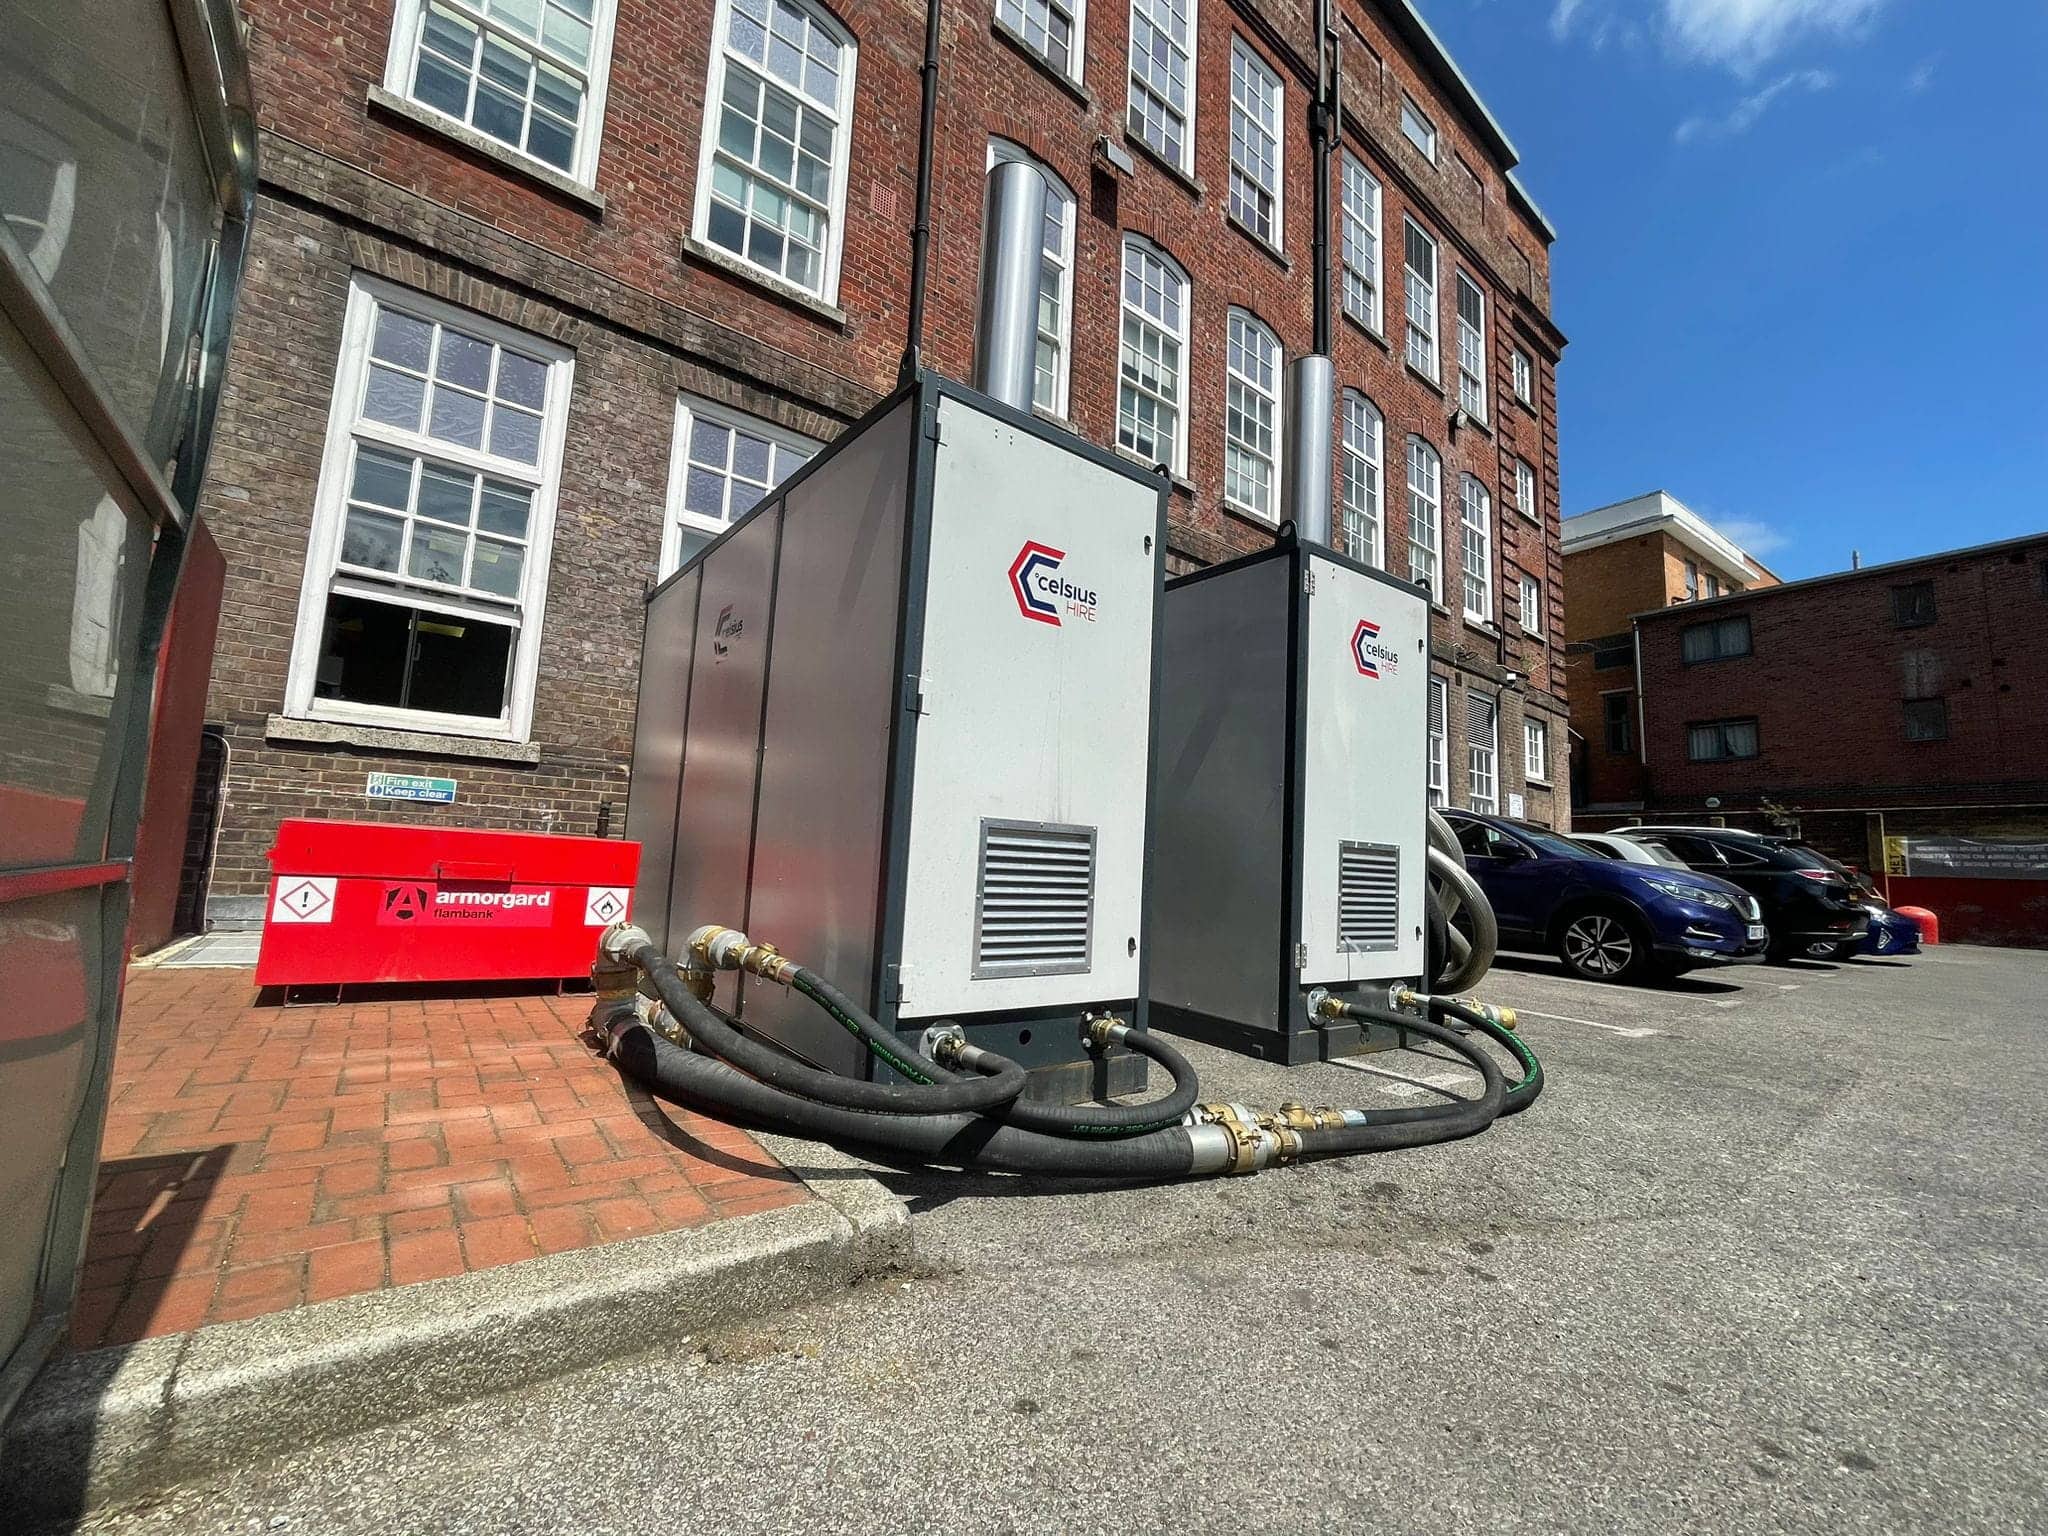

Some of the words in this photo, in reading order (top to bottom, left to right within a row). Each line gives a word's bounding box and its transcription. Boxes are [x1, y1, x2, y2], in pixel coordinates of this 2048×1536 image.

[1066, 601, 1097, 622] HIRE
[386, 776, 409, 787] Fire
[411, 779, 433, 788] exit
[385, 786, 416, 797] Keep
[418, 789, 448, 799] clear
[435, 891, 551, 909] armorgard
[433, 908, 495, 920] flambank
